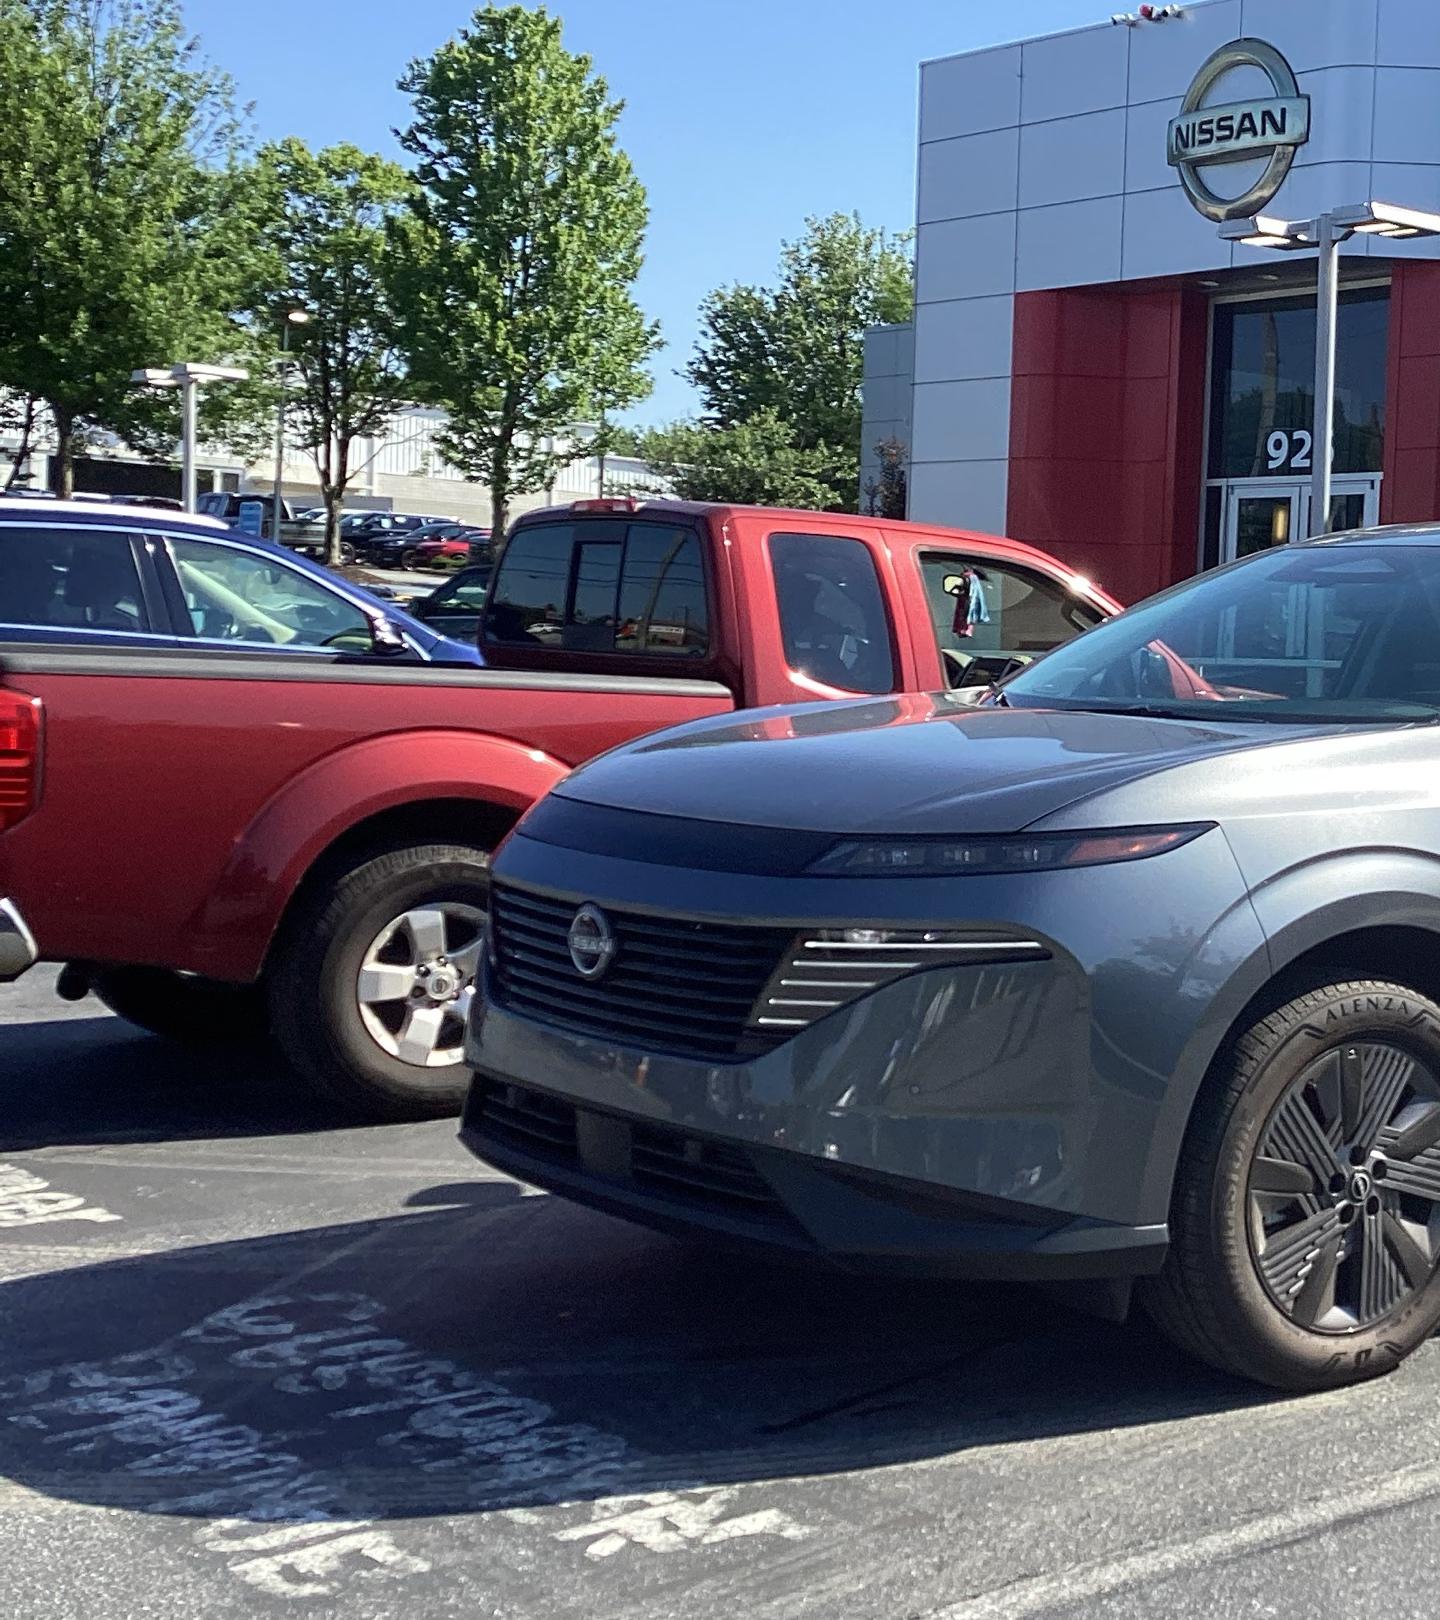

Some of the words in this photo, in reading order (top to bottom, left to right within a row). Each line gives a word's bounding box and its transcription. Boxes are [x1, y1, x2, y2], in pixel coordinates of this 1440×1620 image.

[1172, 107, 1287, 153] NISSAN
[1266, 429, 1335, 470] 92
[1326, 996, 1409, 1024] ALENZA
